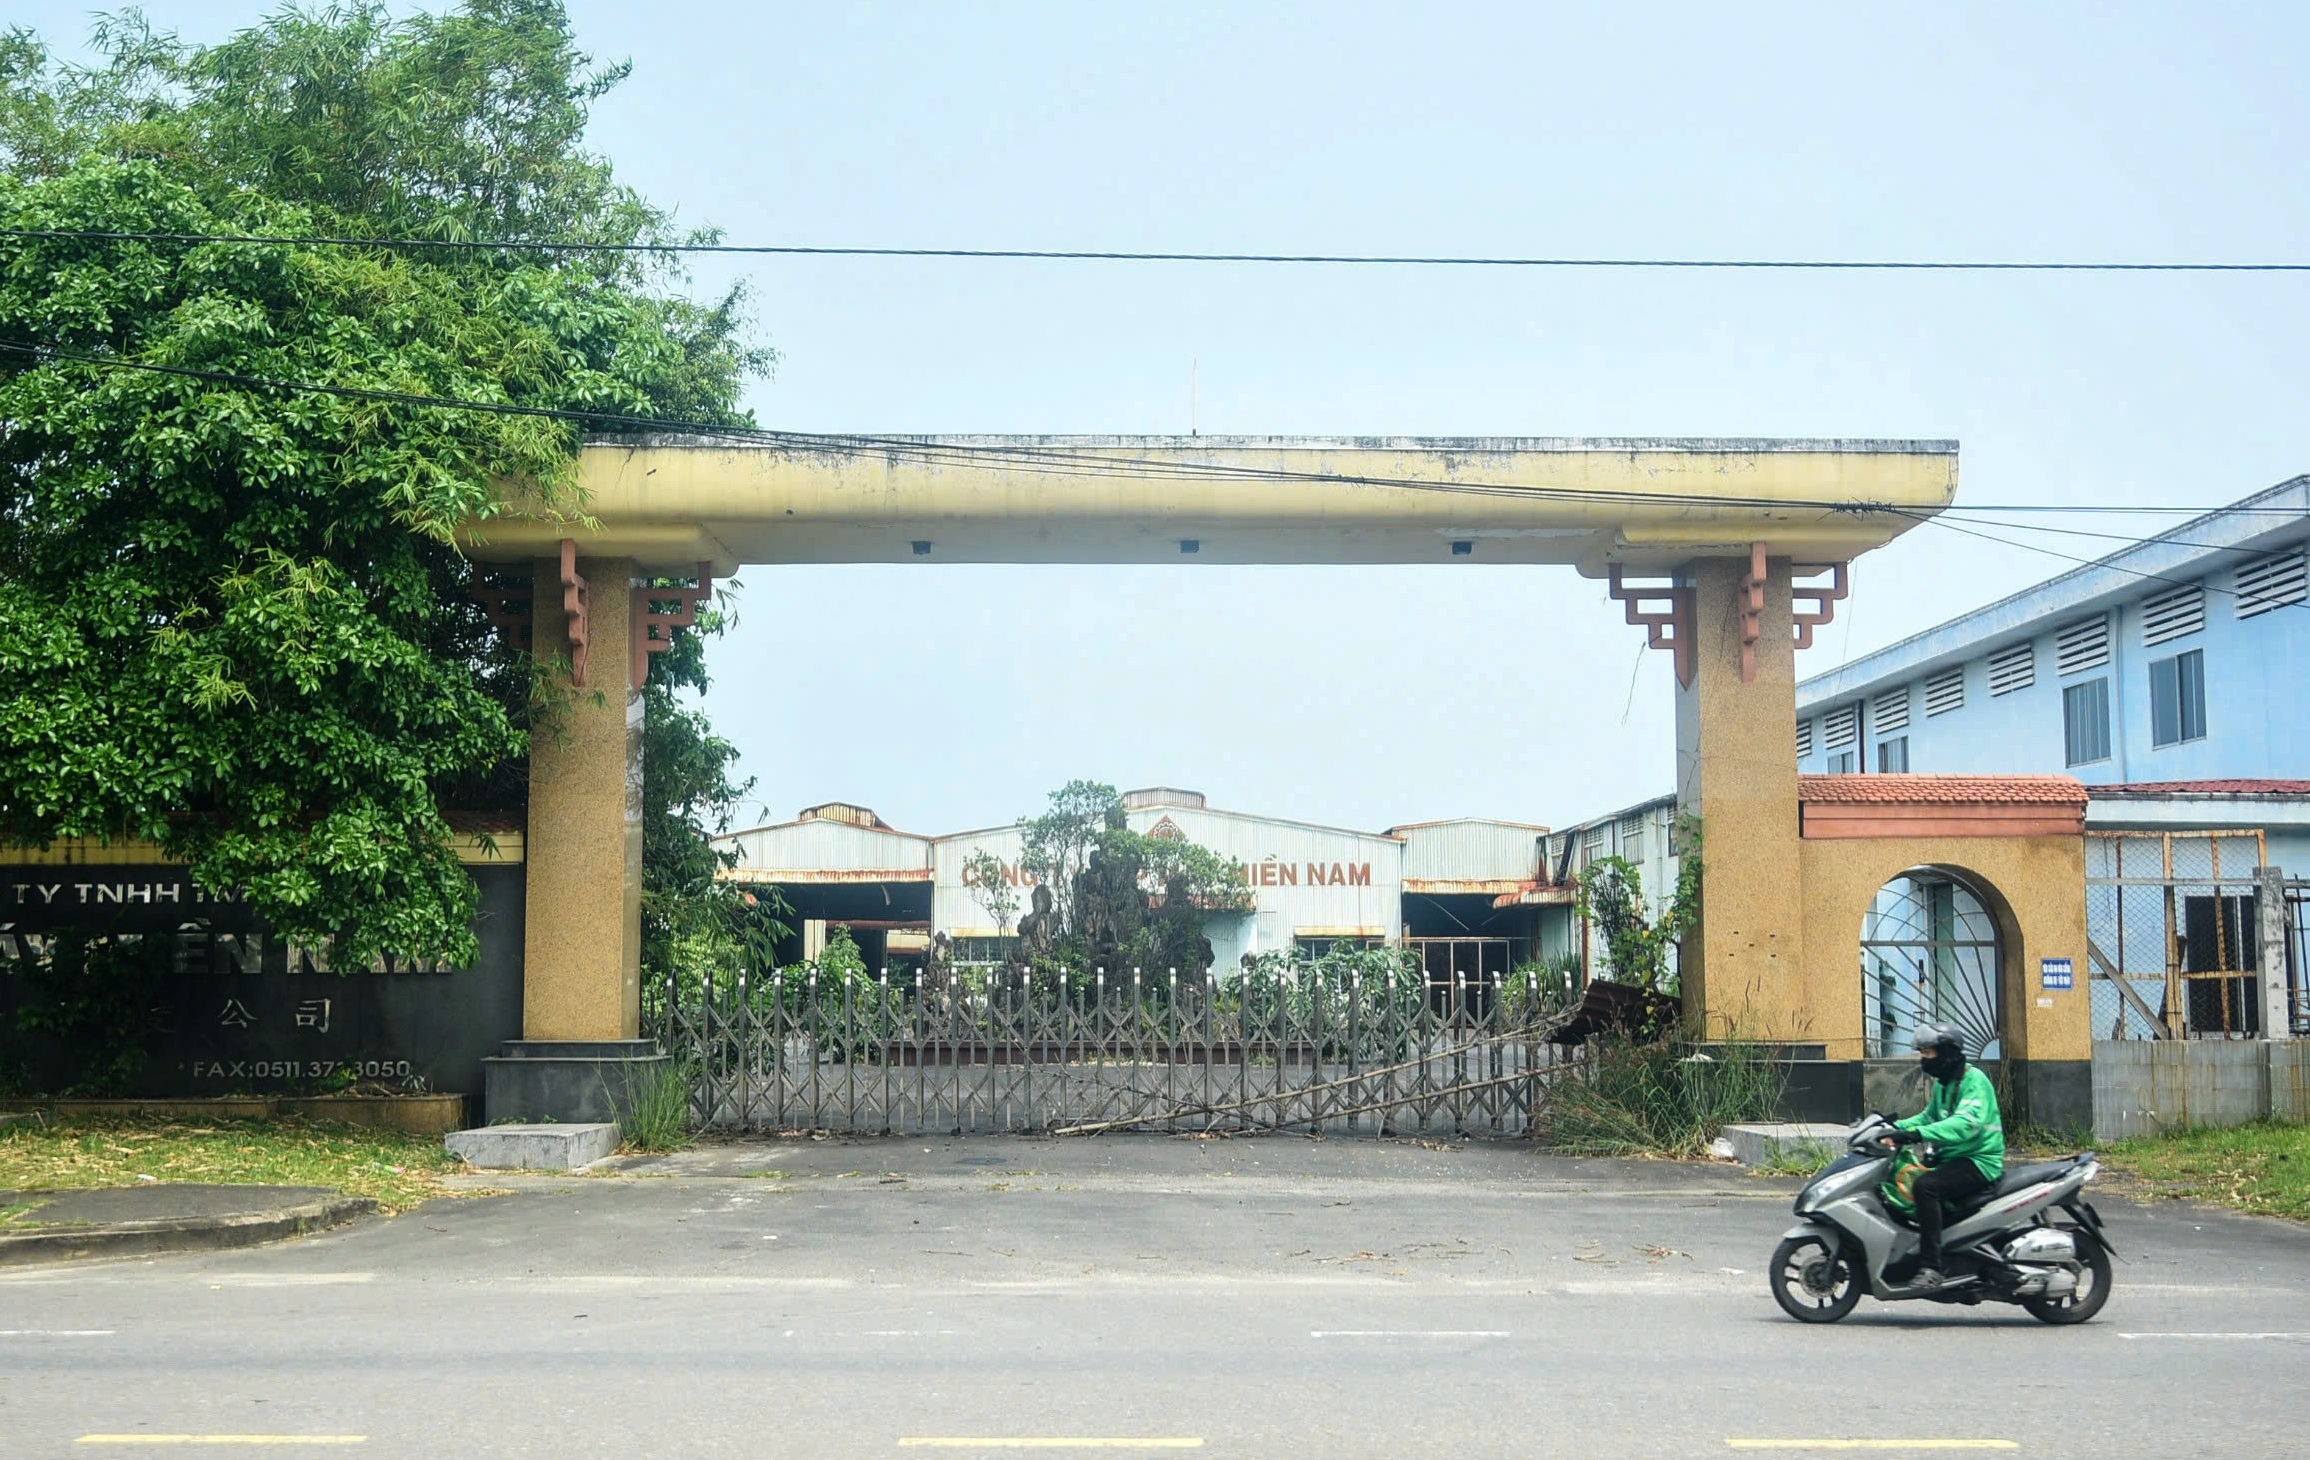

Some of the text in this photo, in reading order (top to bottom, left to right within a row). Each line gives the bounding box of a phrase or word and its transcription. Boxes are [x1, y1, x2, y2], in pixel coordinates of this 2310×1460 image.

[1307, 862, 1371, 886] NAM
[12, 883, 62, 904] TY
[74, 883, 181, 904] TNHH
[193, 1060, 411, 1079] FAX:0511.373050
